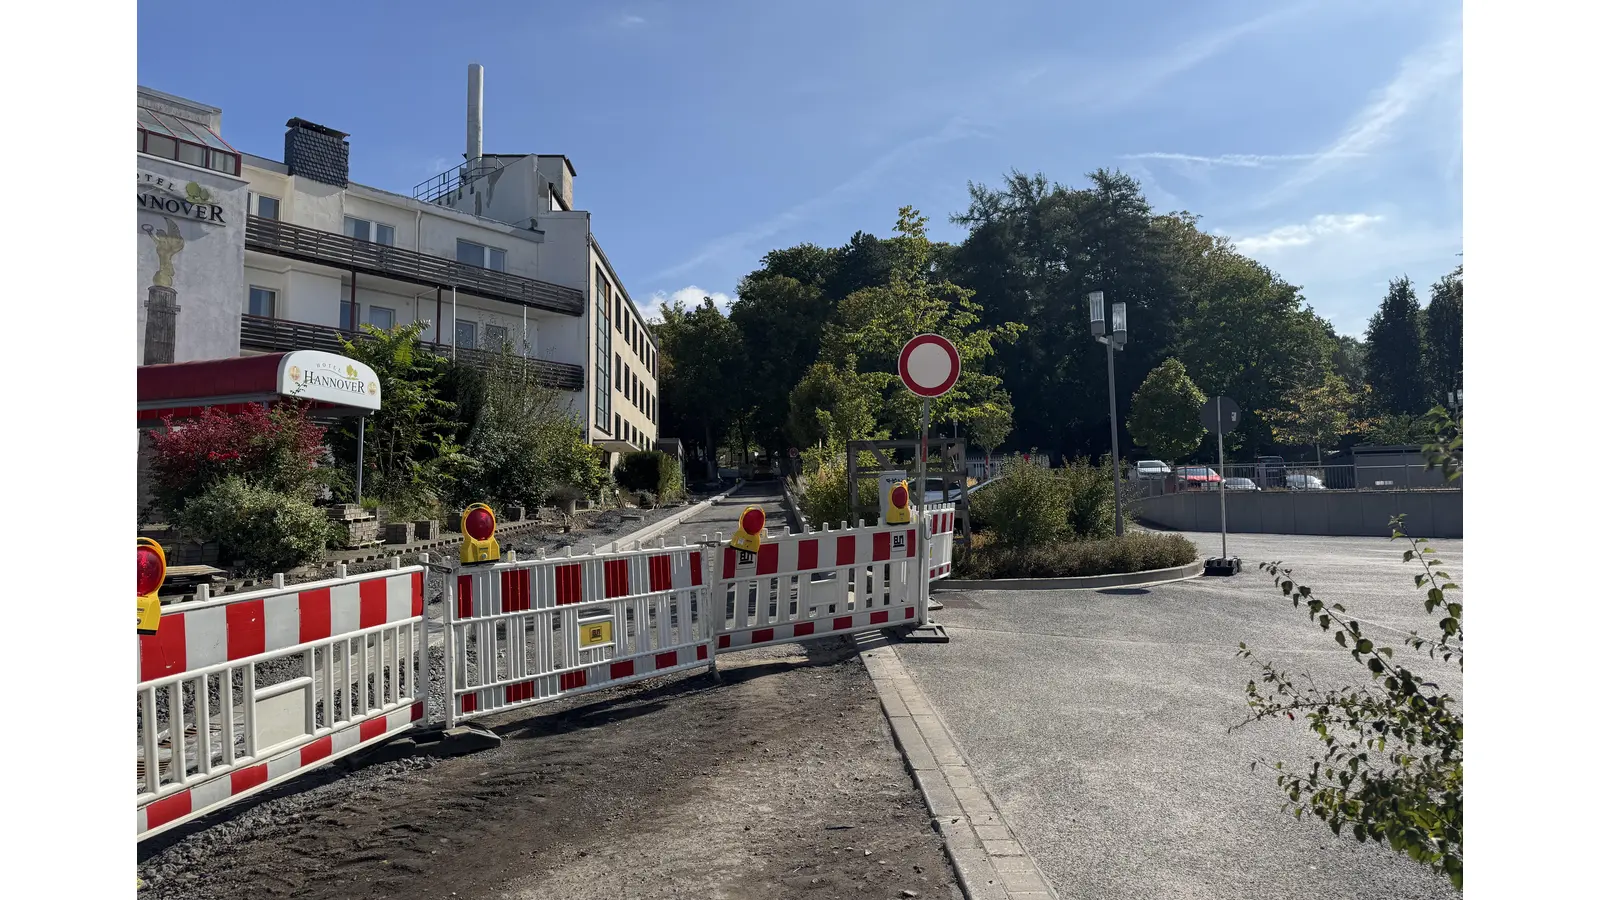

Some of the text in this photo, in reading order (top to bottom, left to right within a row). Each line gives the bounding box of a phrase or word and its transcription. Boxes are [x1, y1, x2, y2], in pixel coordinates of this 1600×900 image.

[137, 173, 174, 192] TEL
[316, 362, 342, 373] HOTEL
[304, 369, 365, 394] HANNOVER
